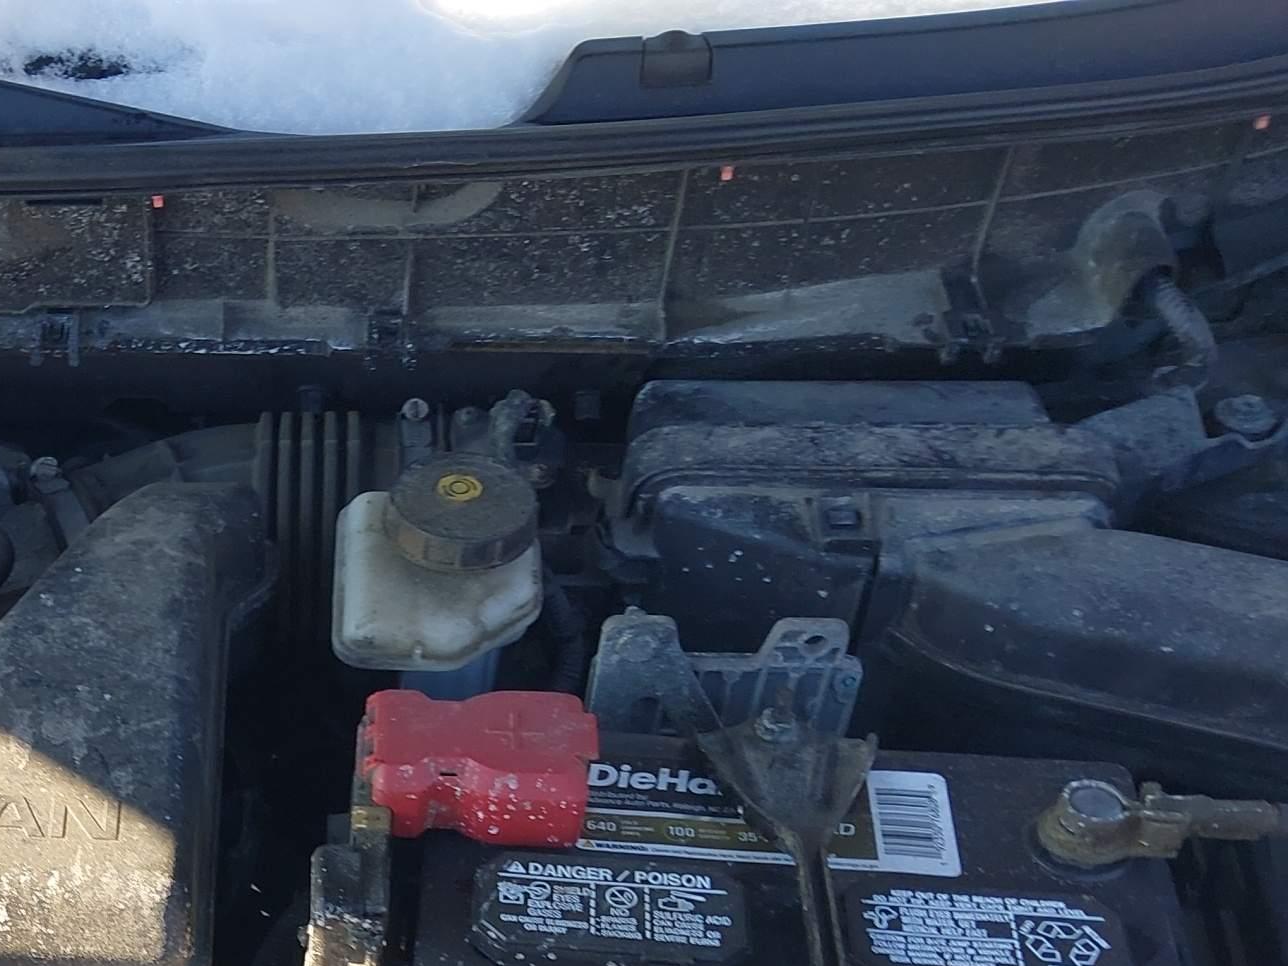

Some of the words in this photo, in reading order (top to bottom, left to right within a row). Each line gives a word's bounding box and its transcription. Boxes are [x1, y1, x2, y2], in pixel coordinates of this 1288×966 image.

[587, 763, 722, 796] DieHa
[586, 820, 617, 832] 640
[668, 825, 696, 838] 100
[528, 862, 613, 881] DANGER
[634, 870, 712, 889] POISON
[610, 906, 630, 917] NO
[653, 910, 704, 924] SULFURIC
[705, 915, 732, 926] ACID
